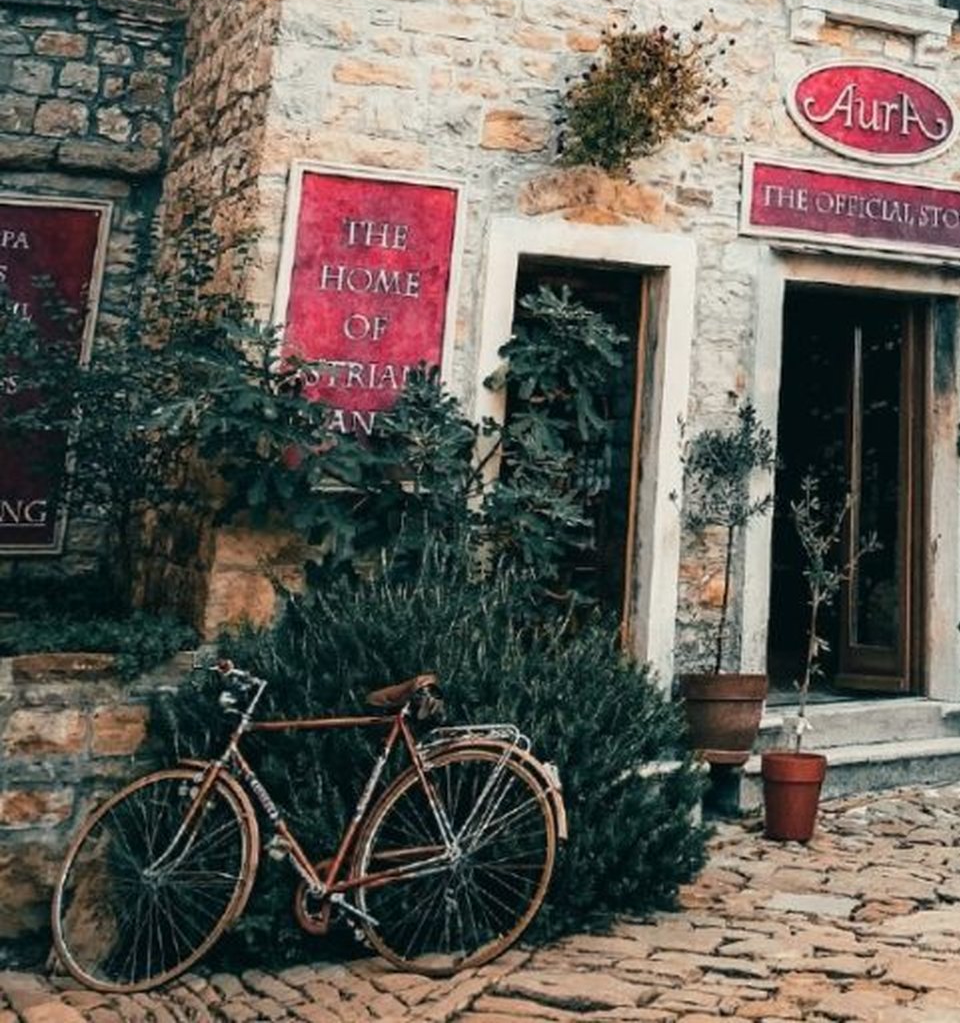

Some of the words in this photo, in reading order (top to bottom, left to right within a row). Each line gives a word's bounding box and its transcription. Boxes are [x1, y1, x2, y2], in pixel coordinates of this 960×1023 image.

[763, 184, 808, 213] THE
[815, 191, 915, 227] OFFICIAL
[344, 220, 409, 252] THE
[319, 264, 420, 298] HOME
[344, 314, 389, 342] OF
